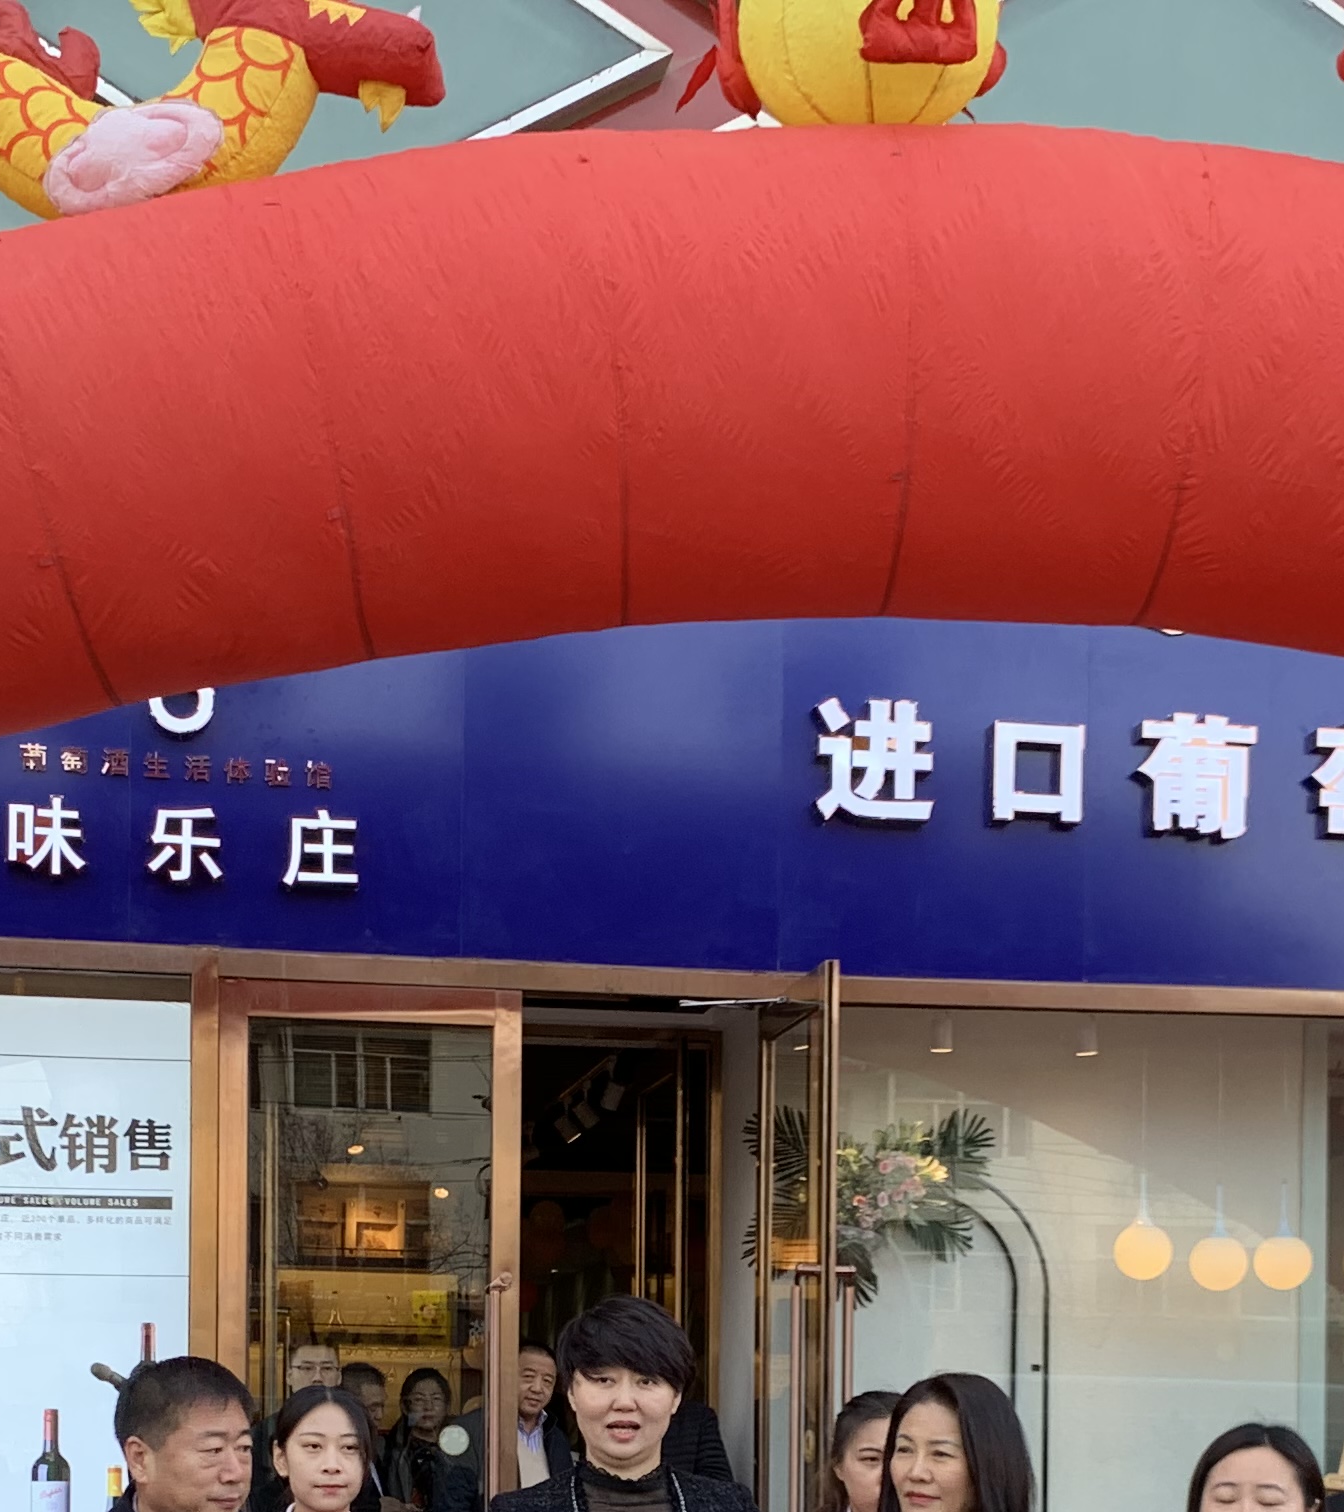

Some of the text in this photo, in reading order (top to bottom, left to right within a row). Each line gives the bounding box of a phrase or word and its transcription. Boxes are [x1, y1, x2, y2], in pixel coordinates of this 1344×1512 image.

[18, 742, 334, 790] 葡萄酒生活体验馆
[5, 794, 361, 890] 味乐庄
[64, 1196, 102, 1207] VOLUME
[107, 1197, 140, 1208] SALES
